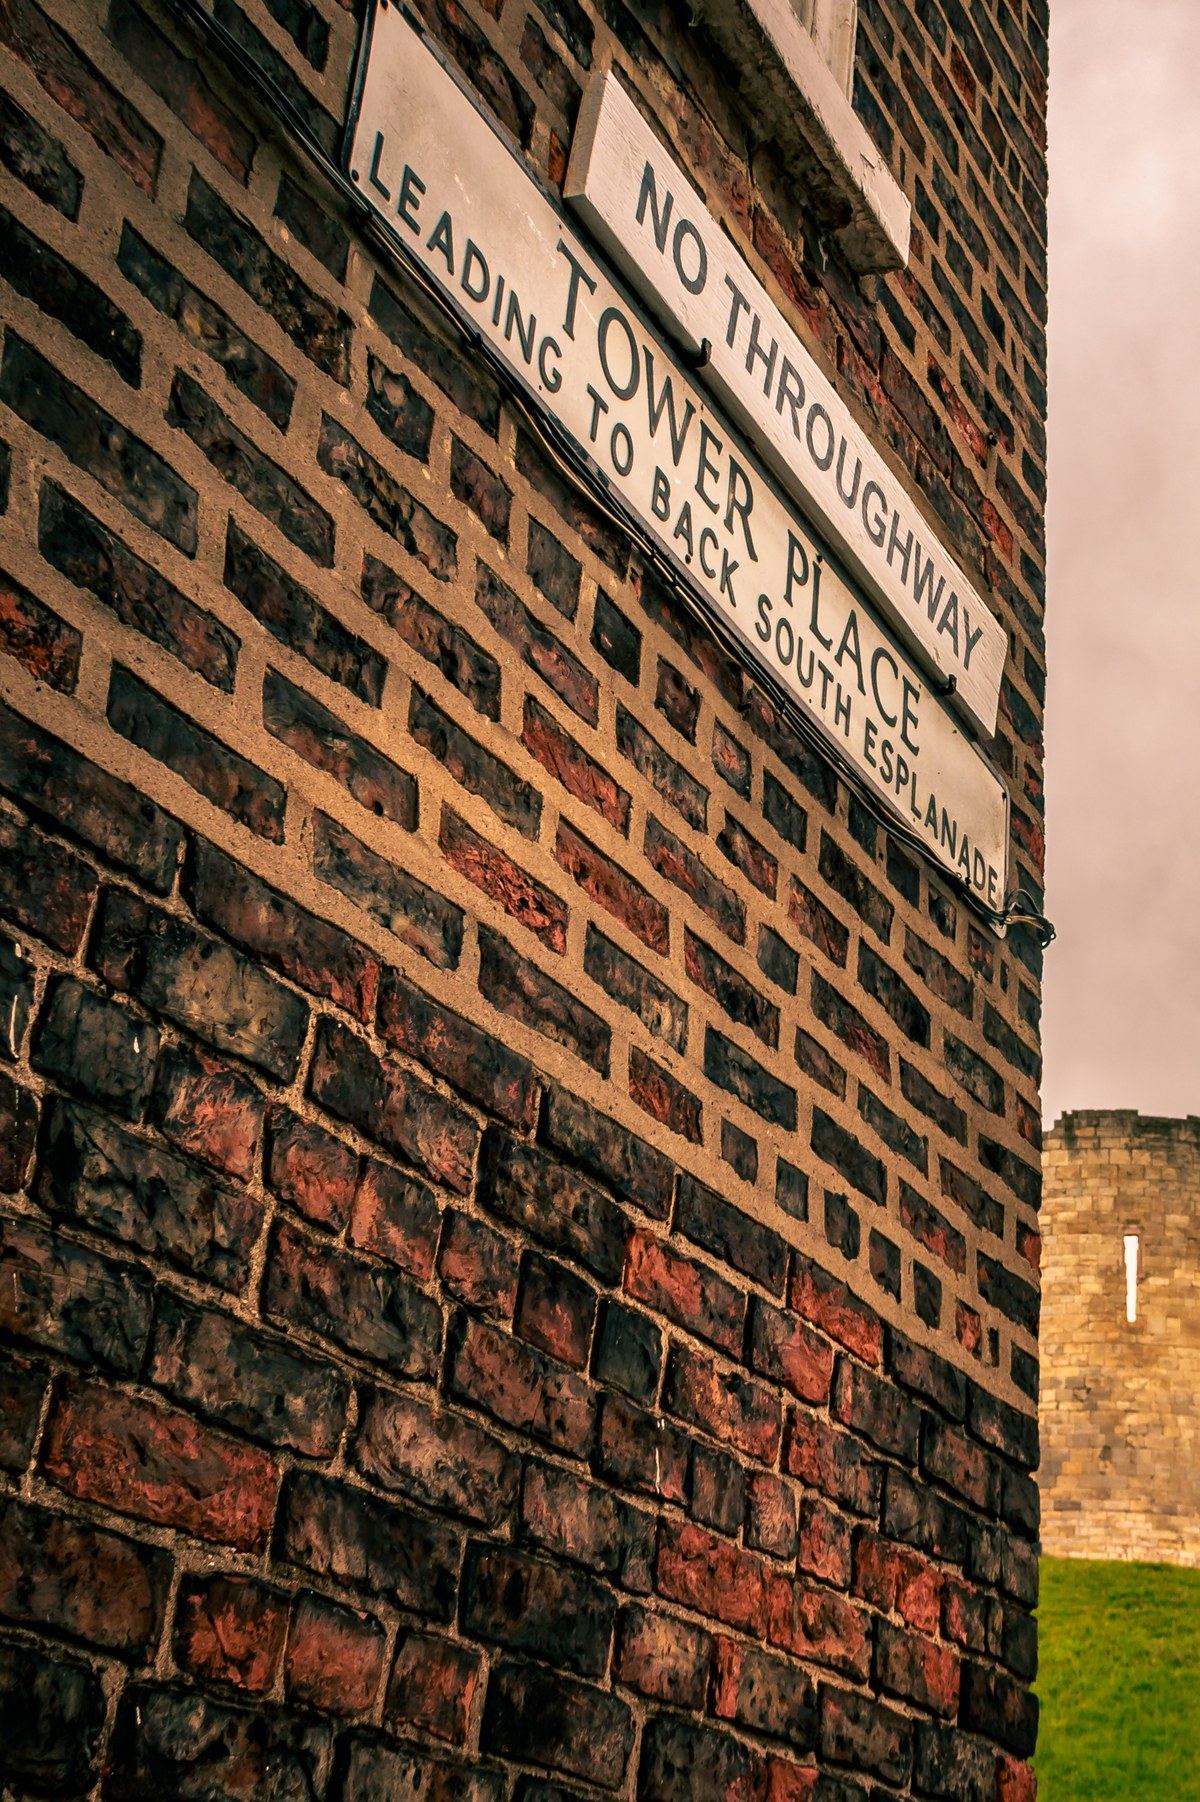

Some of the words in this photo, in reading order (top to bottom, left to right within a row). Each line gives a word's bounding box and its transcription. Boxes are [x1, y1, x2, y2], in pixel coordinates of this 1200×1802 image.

[368, 130, 563, 394] LEADING
[586, 383, 634, 477] TO
[651, 465, 740, 608] BACK
[754, 593, 853, 737] SOUTH
[863, 717, 999, 908] ESPLANADE
[556, 238, 759, 563] TOWER
[783, 529, 922, 757] PLACE
[635, 160, 708, 296] NO
[724, 273, 983, 672] THROUGHWAY
